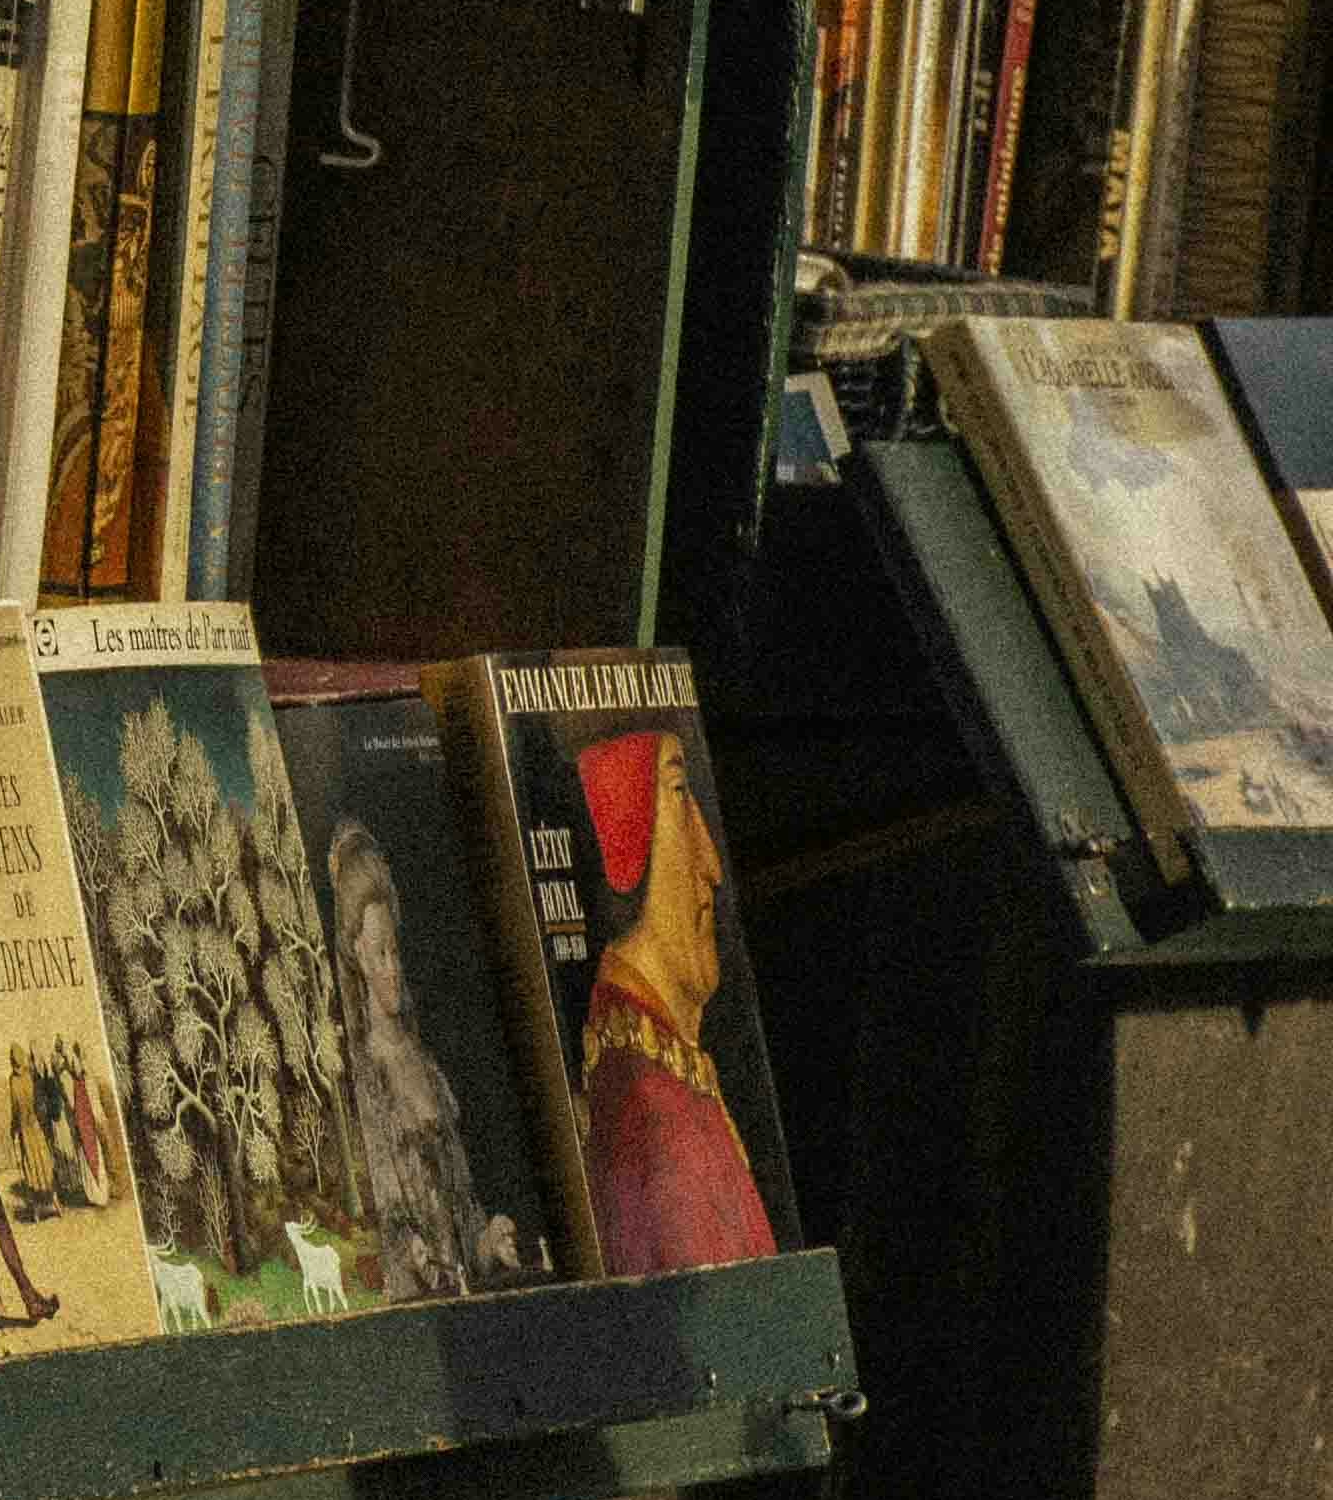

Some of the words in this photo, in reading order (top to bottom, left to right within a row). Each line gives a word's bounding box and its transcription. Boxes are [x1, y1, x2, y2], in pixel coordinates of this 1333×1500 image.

[90, 618, 123, 653] Les
[128, 617, 182, 652] maîtres
[184, 612, 201, 650] de
[203, 614, 229, 651] l'art
[500, 665, 596, 713] EMMANUEL
[591, 664, 617, 709] LE
[613, 664, 643, 709] ROY
[639, 662, 700, 709] LADURIE
[12, 890, 37, 919] DE
[538, 879, 586, 922] ROYAL
